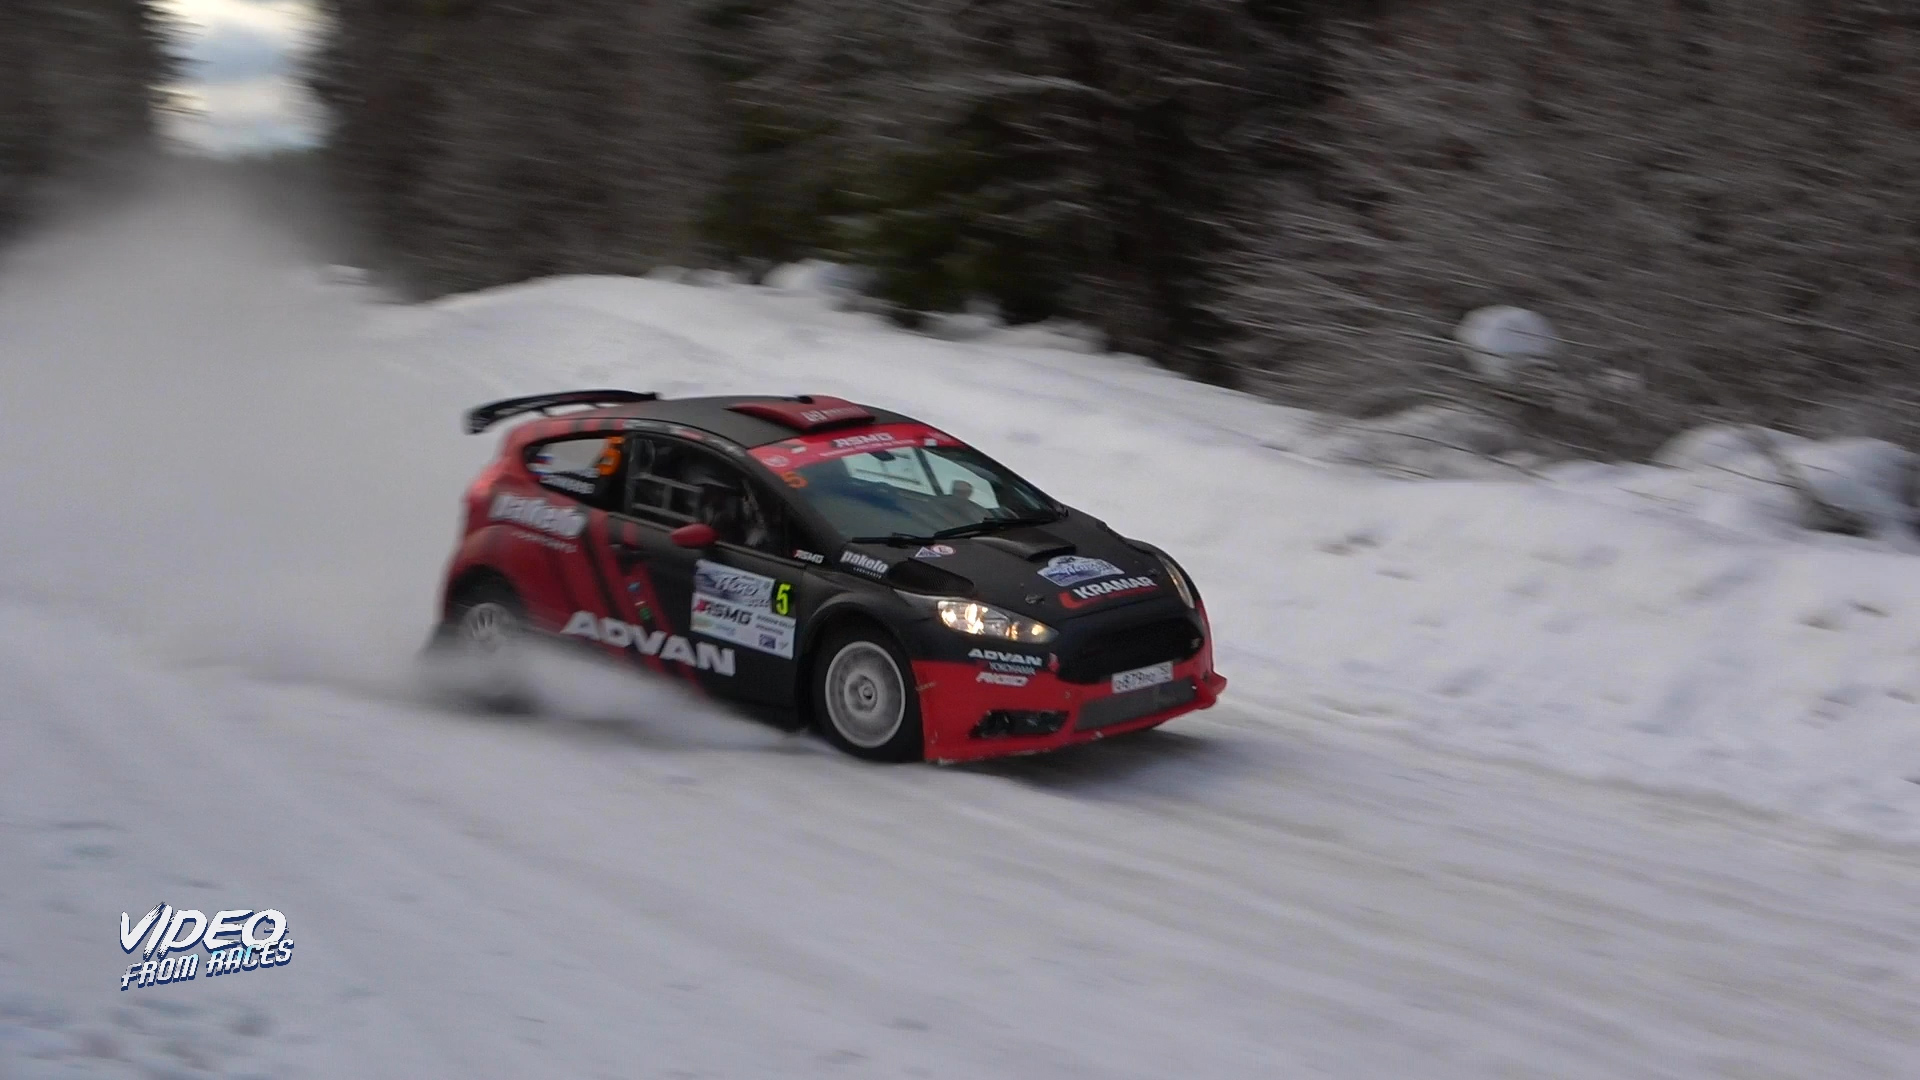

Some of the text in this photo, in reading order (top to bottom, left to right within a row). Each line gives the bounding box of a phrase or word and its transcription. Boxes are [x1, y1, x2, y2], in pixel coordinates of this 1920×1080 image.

[597, 436, 625, 475] 5
[839, 550, 889, 574] pakelo
[776, 583, 792, 616] 5
[1072, 576, 1157, 600] KRAMAR
[559, 609, 736, 677] ADVAN
[967, 648, 1043, 667] ADVAN
